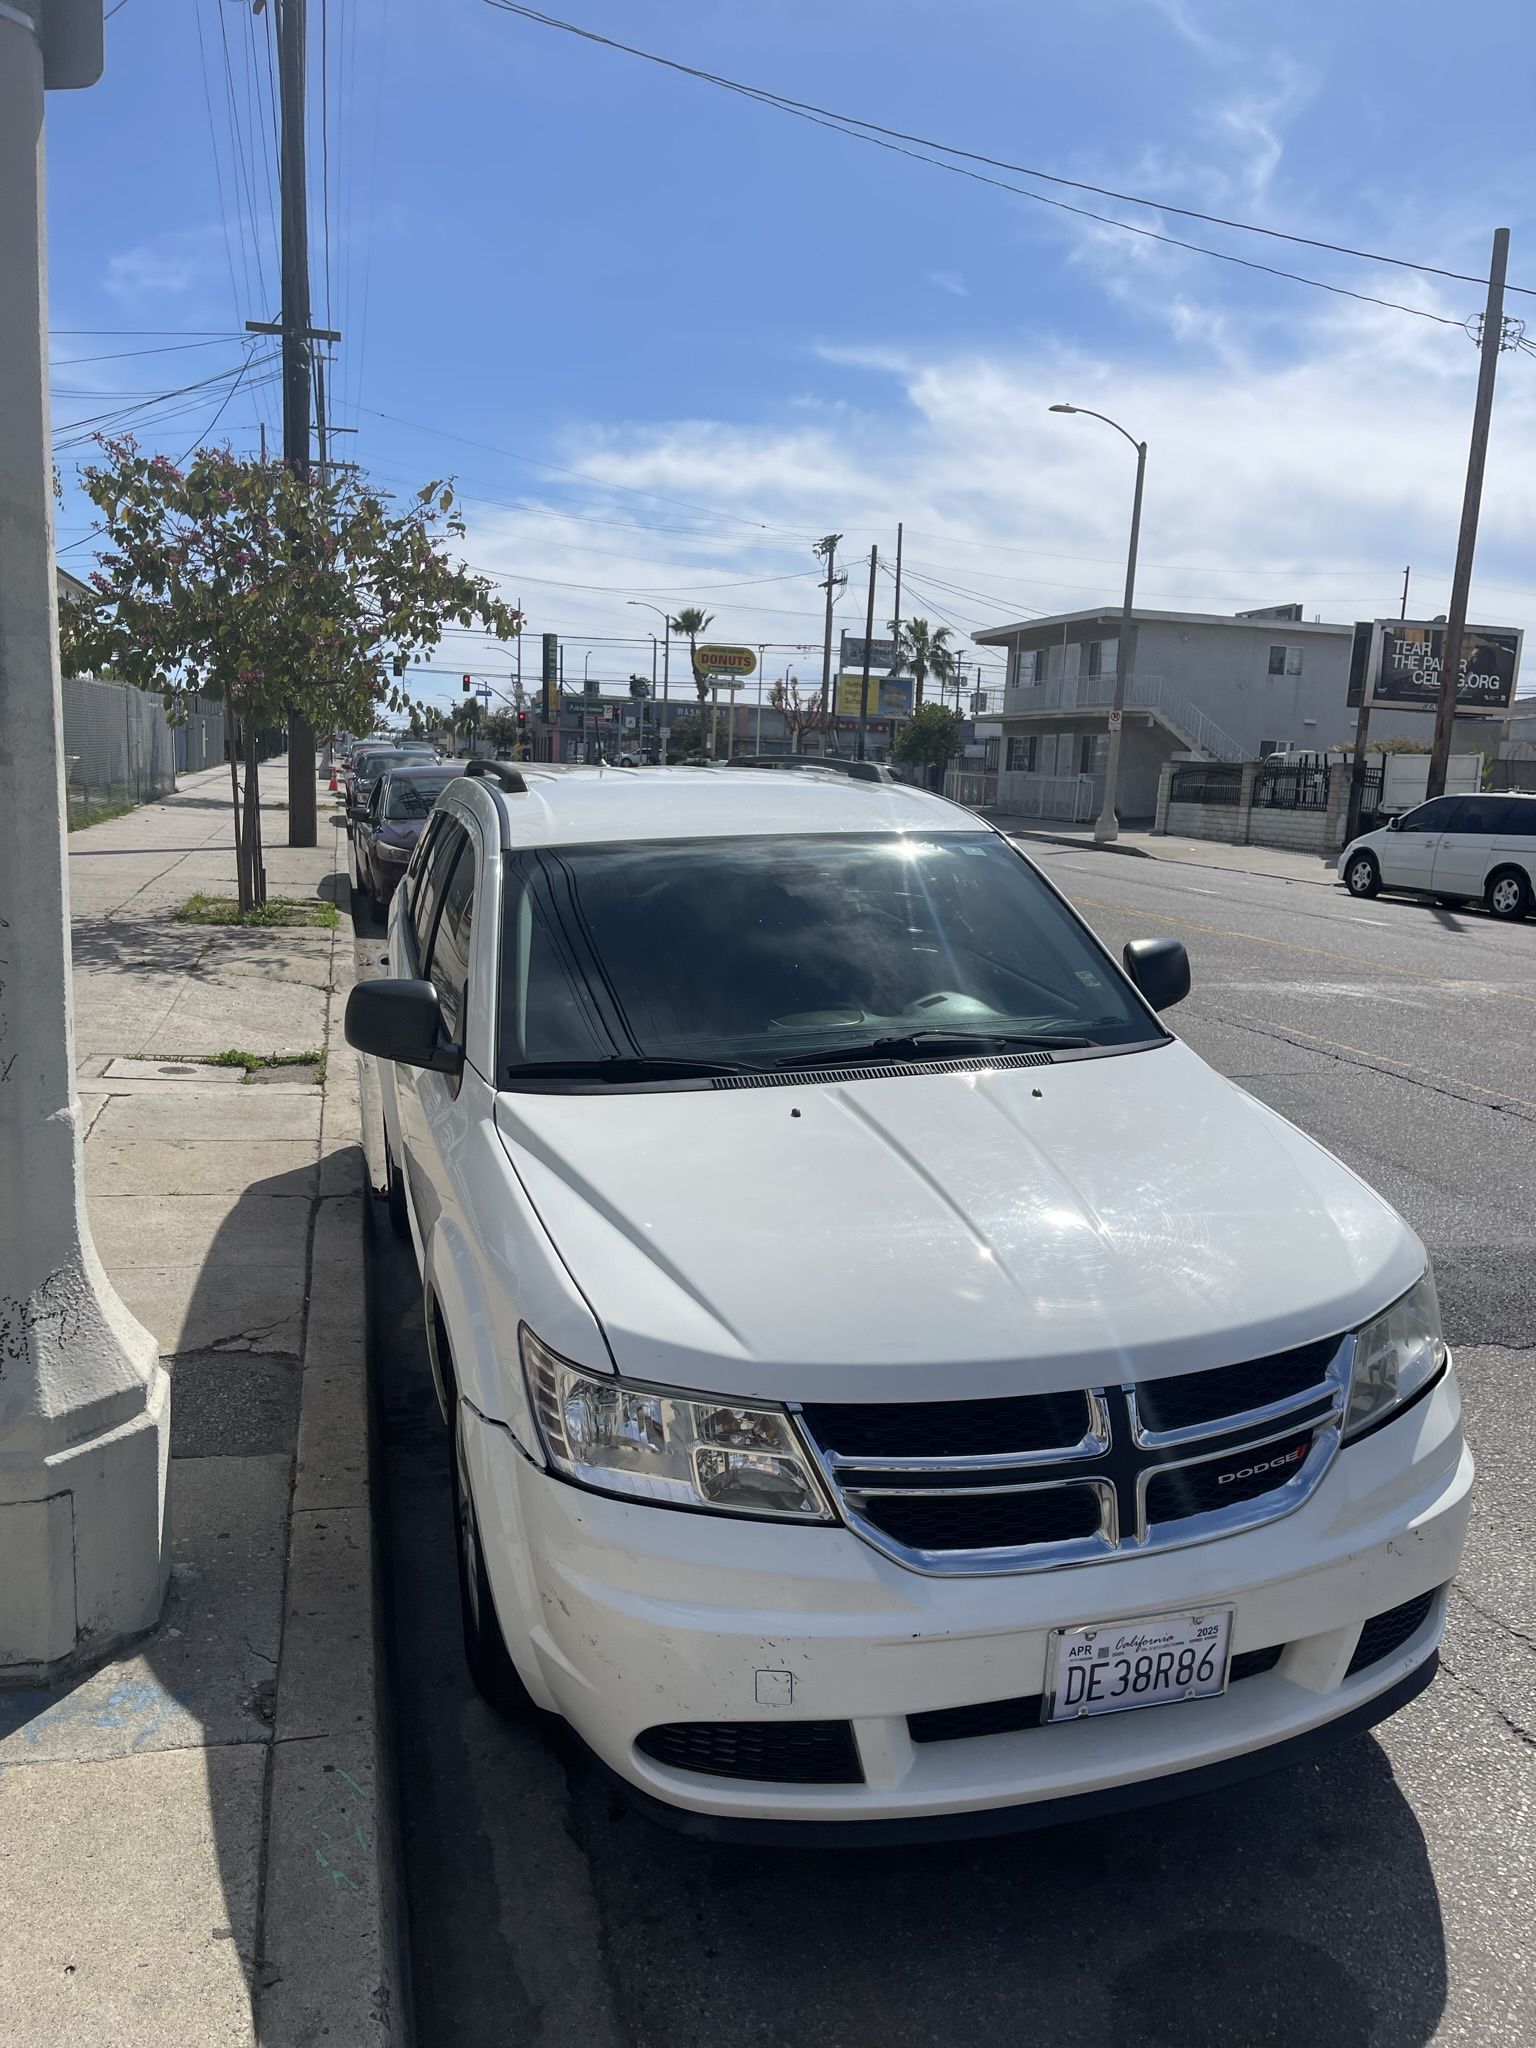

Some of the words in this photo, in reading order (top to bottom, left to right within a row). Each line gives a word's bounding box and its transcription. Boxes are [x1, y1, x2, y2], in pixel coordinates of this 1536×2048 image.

[1394, 640, 1432, 656] TEAR
[701, 653, 751, 667] DONUTS
[1392, 654, 1420, 670] THE
[1423, 657, 1468, 673] PAR
[1412, 670, 1500, 689] CEILG.ORG
[677, 707, 700, 717] WASH
[1218, 1450, 1299, 1484] DODGE
[1196, 1625, 1219, 1638] 2025
[1115, 1632, 1175, 1653] California
[1068, 1645, 1092, 1658] APR
[1064, 1642, 1217, 1706] DE38R86
